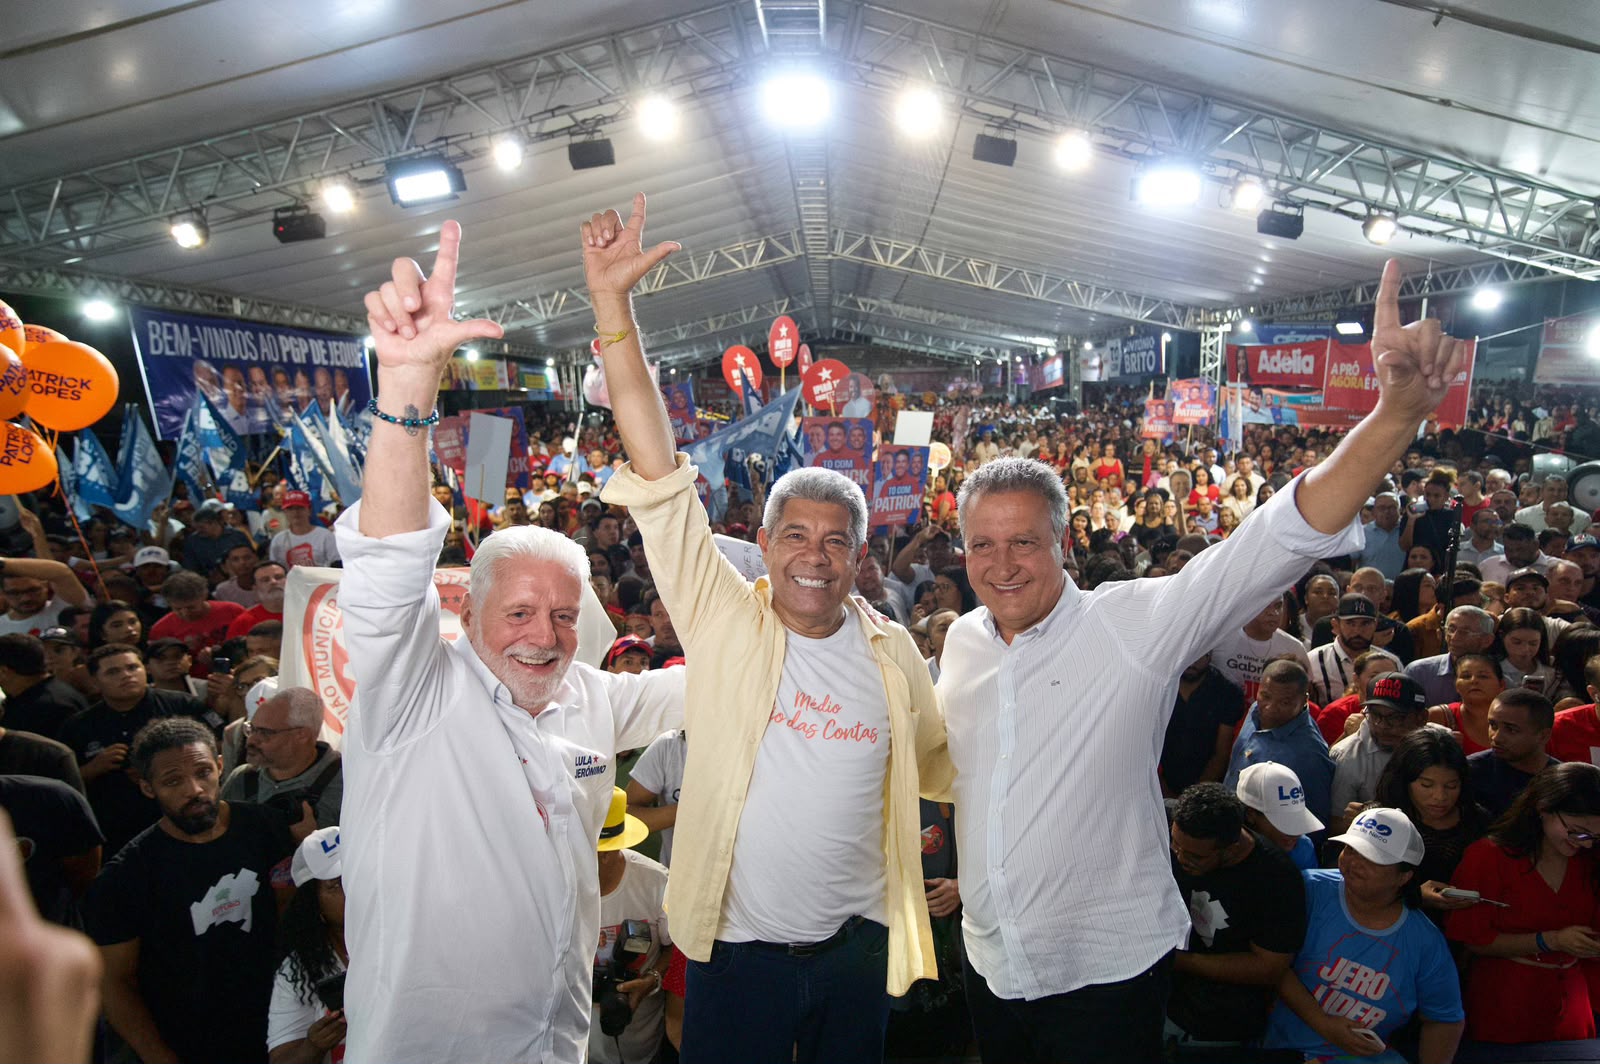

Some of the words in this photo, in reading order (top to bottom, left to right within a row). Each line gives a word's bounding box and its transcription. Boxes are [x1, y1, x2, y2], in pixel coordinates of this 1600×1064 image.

[147, 320, 260, 361] BEM-VINDOS
[258, 332, 281, 362] AO
[279, 335, 308, 364] PGP
[309, 339, 329, 367] DE
[1124, 350, 1156, 374] BRITO
[27, 369, 92, 390] ATRICK
[1328, 375, 1364, 390] AGORA
[31, 382, 82, 401] OPES
[874, 494, 922, 513] PATRICK
[314, 598, 339, 680] MUNICIP
[786, 710, 819, 739] das
[822, 718, 879, 744] Contas
[575, 755, 592, 767] LULA
[1277, 785, 1304, 801] Le
[1356, 814, 1393, 837] Leo
[1317, 956, 1391, 1001] JERO
